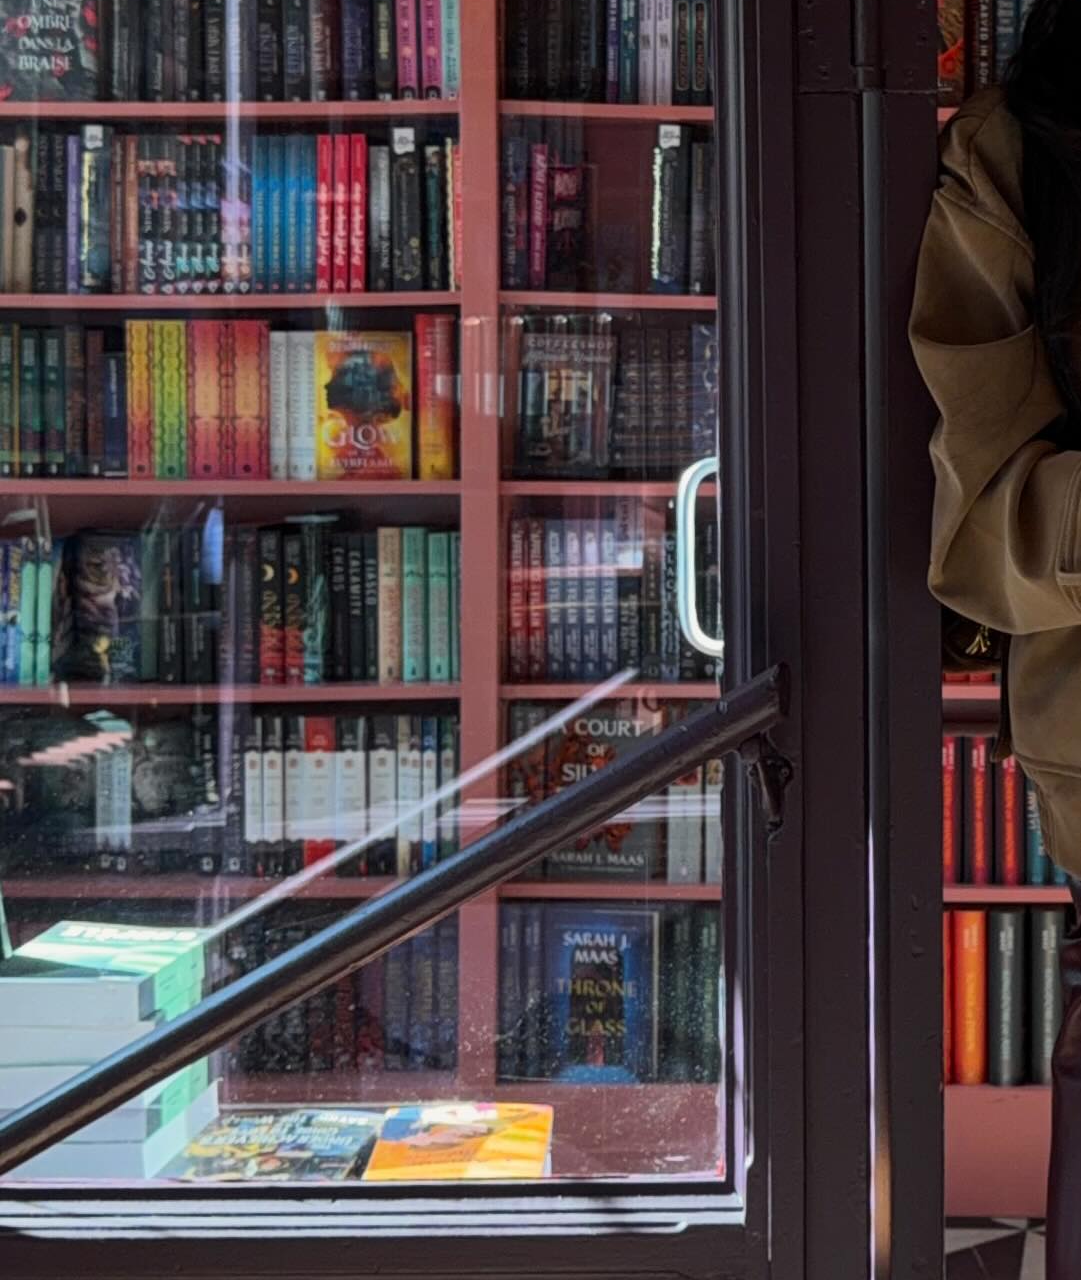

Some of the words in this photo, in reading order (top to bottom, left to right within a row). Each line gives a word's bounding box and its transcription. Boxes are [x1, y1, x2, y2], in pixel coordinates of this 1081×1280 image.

[348, 550, 361, 615] CALAMITY
[574, 719, 641, 737] COURT
[607, 853, 645, 867] MAAS
[563, 932, 615, 947] SARAH
[574, 950, 618, 965] MAAS
[557, 978, 635, 998] THRONE
[566, 1020, 627, 1036] GLASS
